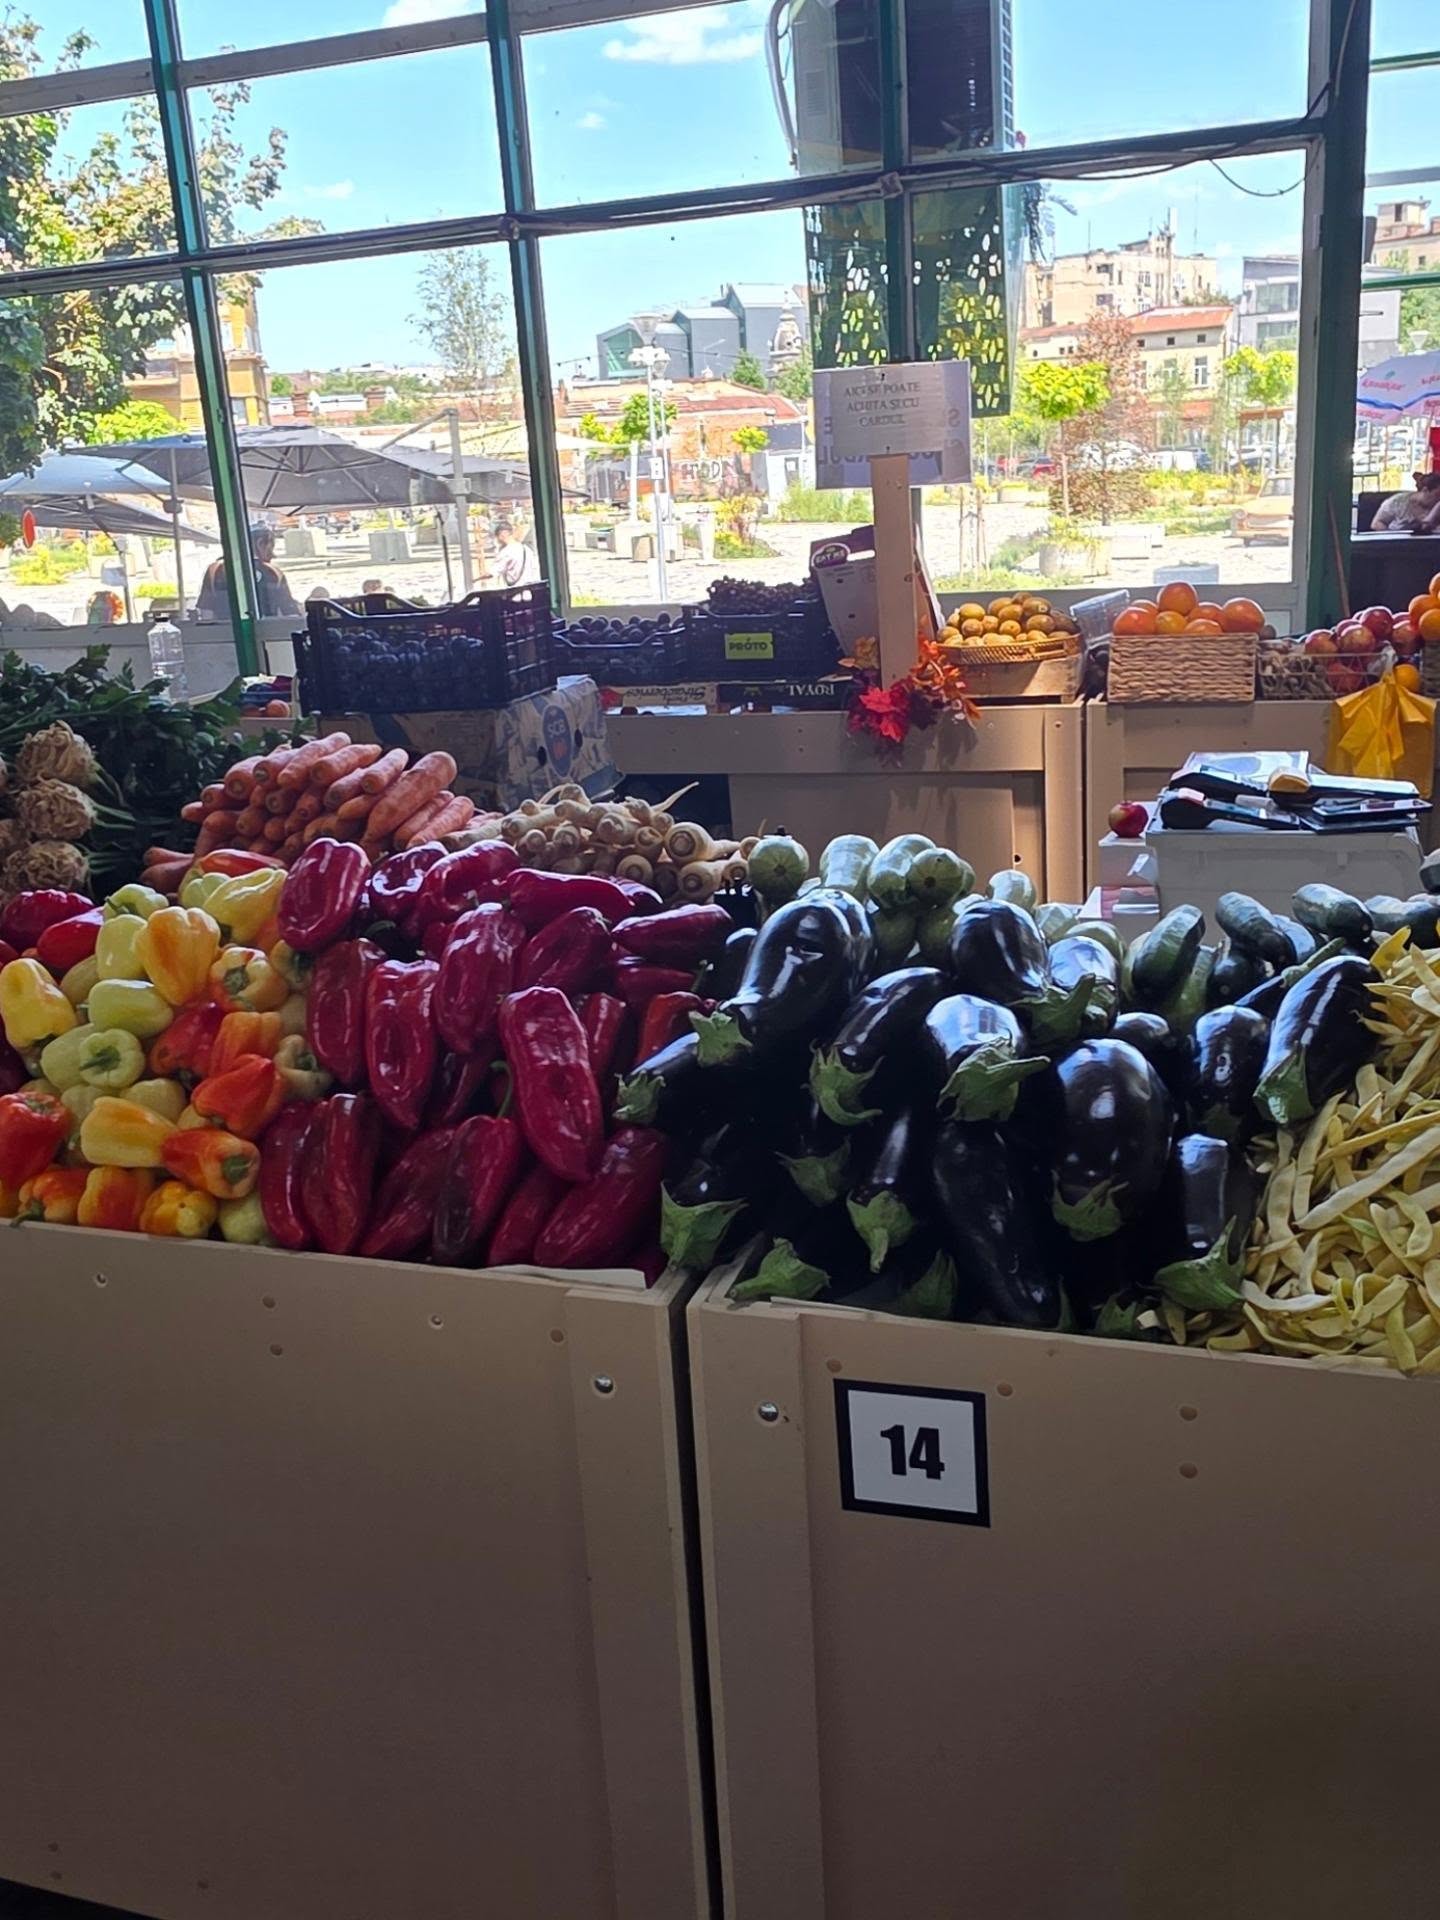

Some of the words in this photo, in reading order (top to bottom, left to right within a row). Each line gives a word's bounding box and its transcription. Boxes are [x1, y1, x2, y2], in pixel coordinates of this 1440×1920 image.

[884, 382, 920, 394] POATE
[788, 684, 835, 697] ROYAL
[880, 1424, 945, 1480] 14
